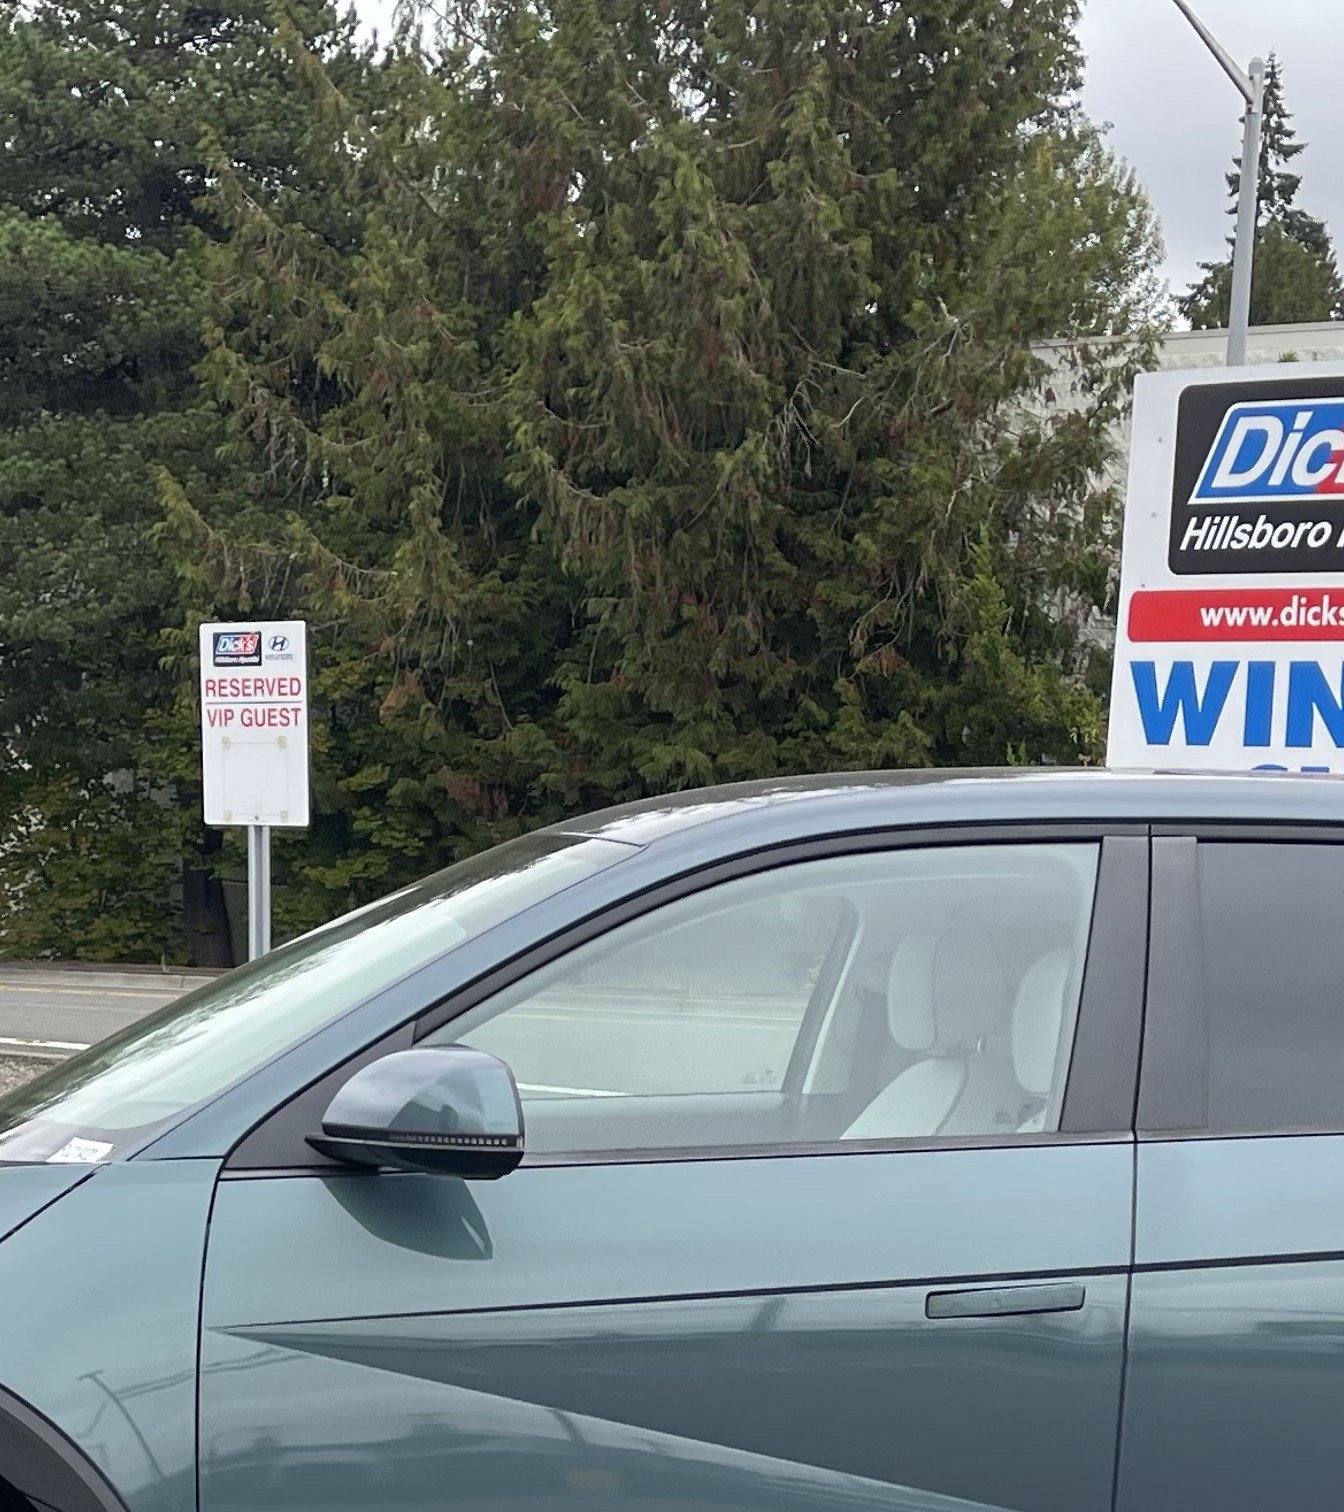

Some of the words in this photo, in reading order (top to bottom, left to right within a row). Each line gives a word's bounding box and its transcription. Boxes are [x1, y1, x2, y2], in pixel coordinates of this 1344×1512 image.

[1180, 514, 1332, 550] Hillsboro
[205, 676, 302, 698] RESERVED
[207, 708, 234, 727] VIP
[240, 707, 302, 727] GUEST
